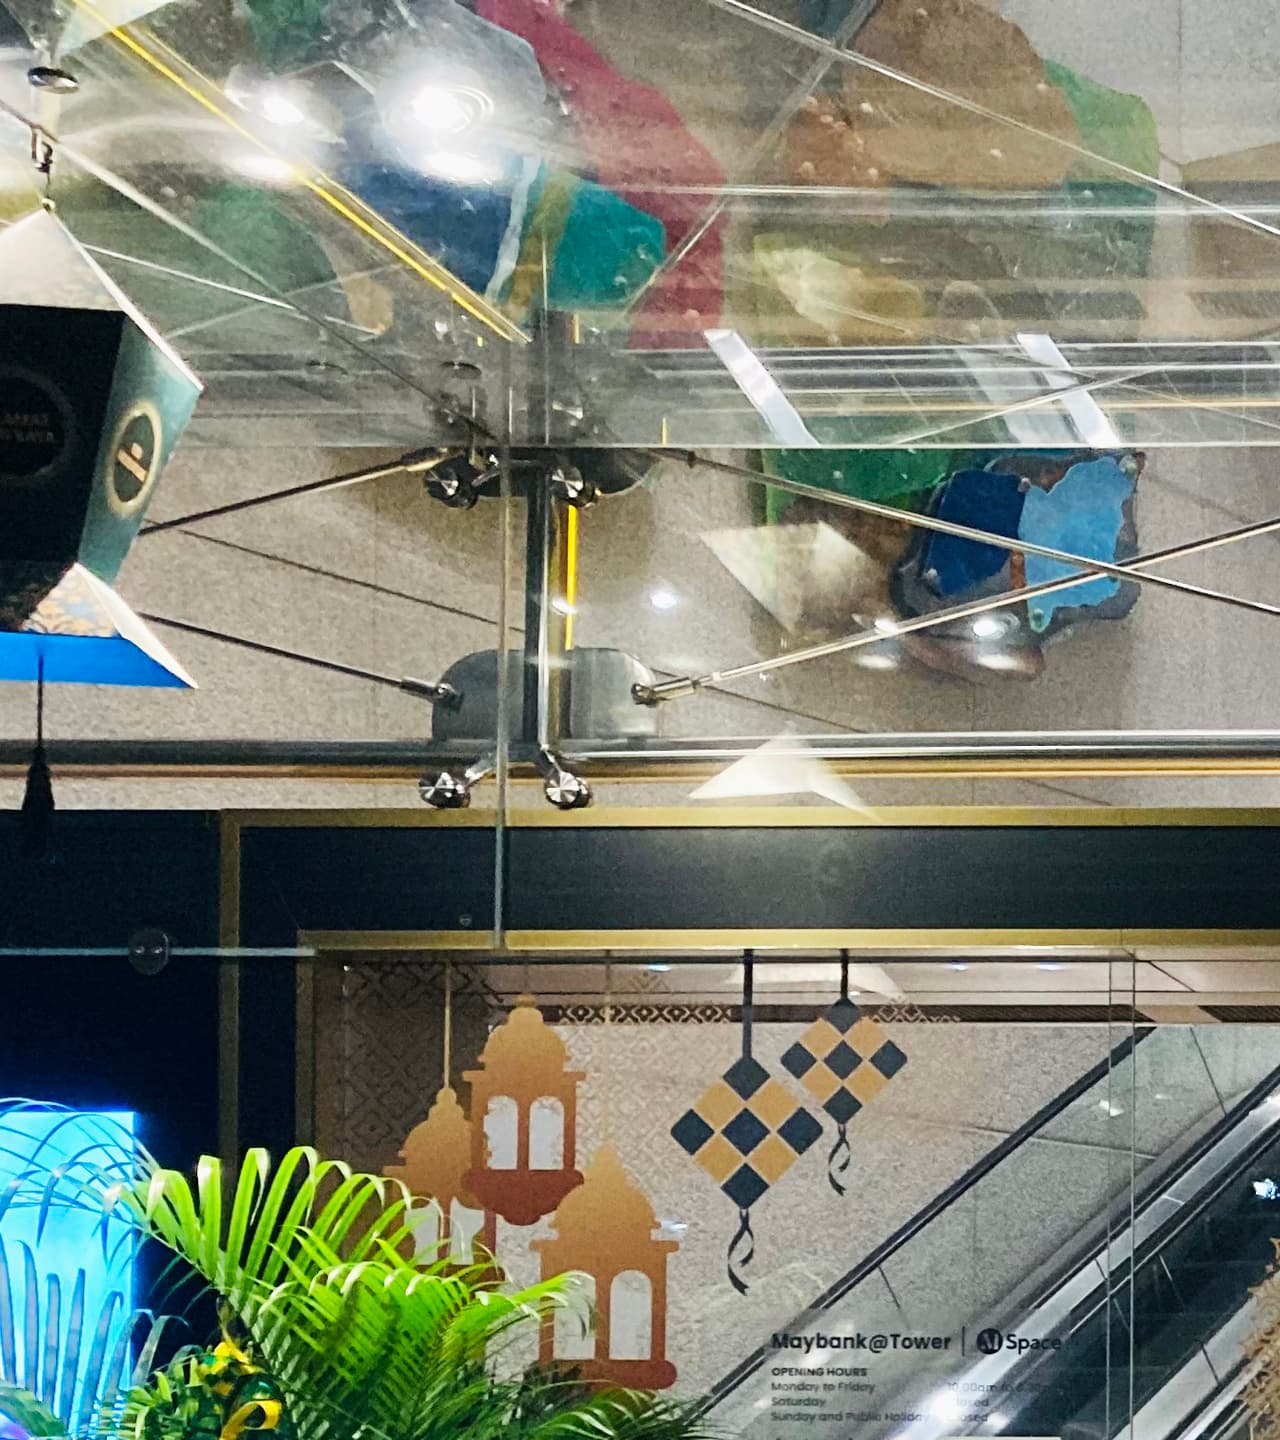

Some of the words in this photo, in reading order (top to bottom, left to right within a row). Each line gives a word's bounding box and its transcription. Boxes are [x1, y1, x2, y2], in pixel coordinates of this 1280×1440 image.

[772, 1332, 952, 1354] Maybank@Tower
[1006, 1333, 1062, 1355] Space
[772, 1367, 824, 1377] OPENING
[826, 1367, 868, 1377] HOURS
[771, 1382, 819, 1394] Monday
[823, 1383, 835, 1392] to
[838, 1382, 876, 1395] Friday
[771, 1397, 826, 1408] Saturday
[771, 1412, 817, 1425] Sunday
[819, 1411, 843, 1422] and
[846, 1411, 881, 1422] Public
